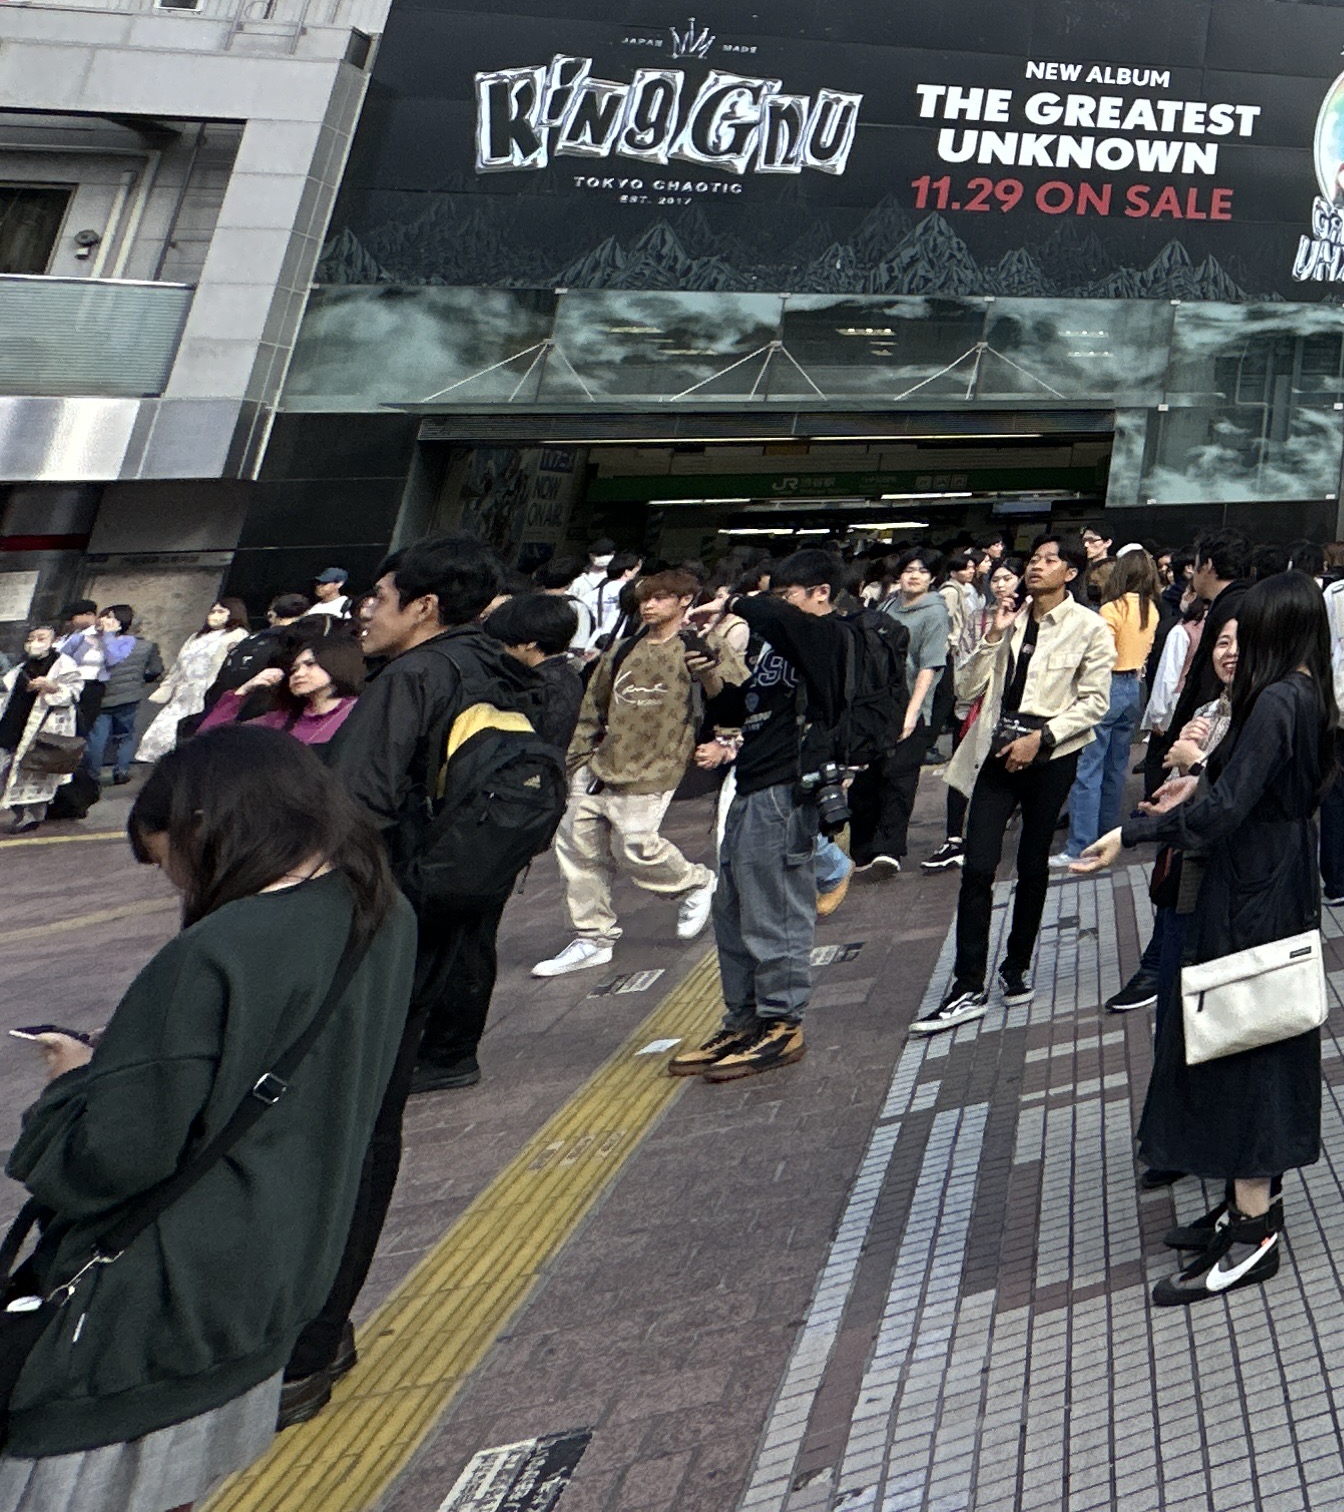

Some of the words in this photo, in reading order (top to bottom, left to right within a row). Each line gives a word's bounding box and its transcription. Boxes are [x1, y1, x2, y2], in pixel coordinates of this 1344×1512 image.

[1025, 60, 1087, 82] NEW
[1091, 64, 1170, 88] ALBUM
[915, 84, 1011, 123] THE
[1024, 90, 1262, 138] GREATEST
[936, 129, 1219, 175] UNKNOWN
[574, 176, 643, 189] TOKYO
[653, 180, 742, 194] CHAOTIC
[620, 194, 651, 204] EST.
[657, 196, 692, 205] 2017
[910, 174, 1024, 214] 11.29
[1036, 181, 1112, 217] ON
[1124, 183, 1234, 221] SALE
